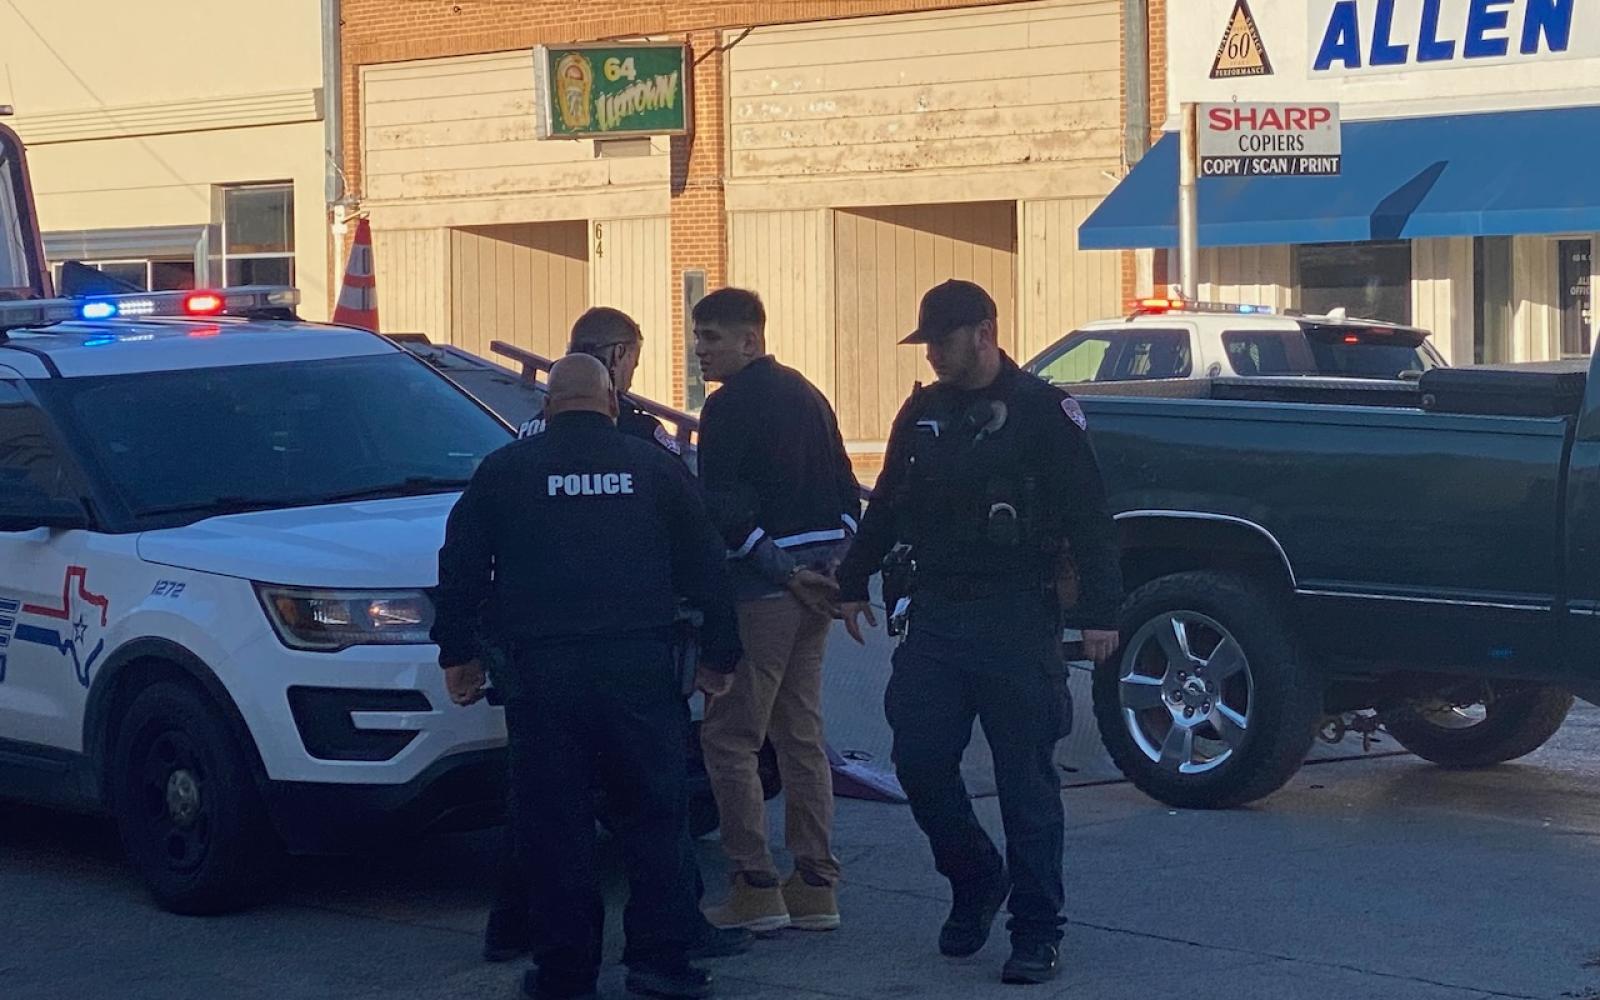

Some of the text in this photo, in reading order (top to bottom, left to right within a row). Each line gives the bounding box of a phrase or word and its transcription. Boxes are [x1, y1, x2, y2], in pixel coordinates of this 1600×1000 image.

[1228, 32, 1250, 59] 60
[1313, 0, 1574, 70] ALLEN
[603, 57, 636, 81] 64
[1215, 66, 1265, 77] PERFORMANCE
[1208, 107, 1331, 131] SHARP
[1238, 134, 1305, 152] COPIERS
[1203, 158, 1241, 175] COPY
[1252, 158, 1288, 174] SCAN
[1300, 157, 1339, 173] PRINT
[595, 223, 604, 258] 64
[548, 473, 634, 496] POLICE
[151, 579, 186, 598] 1272
